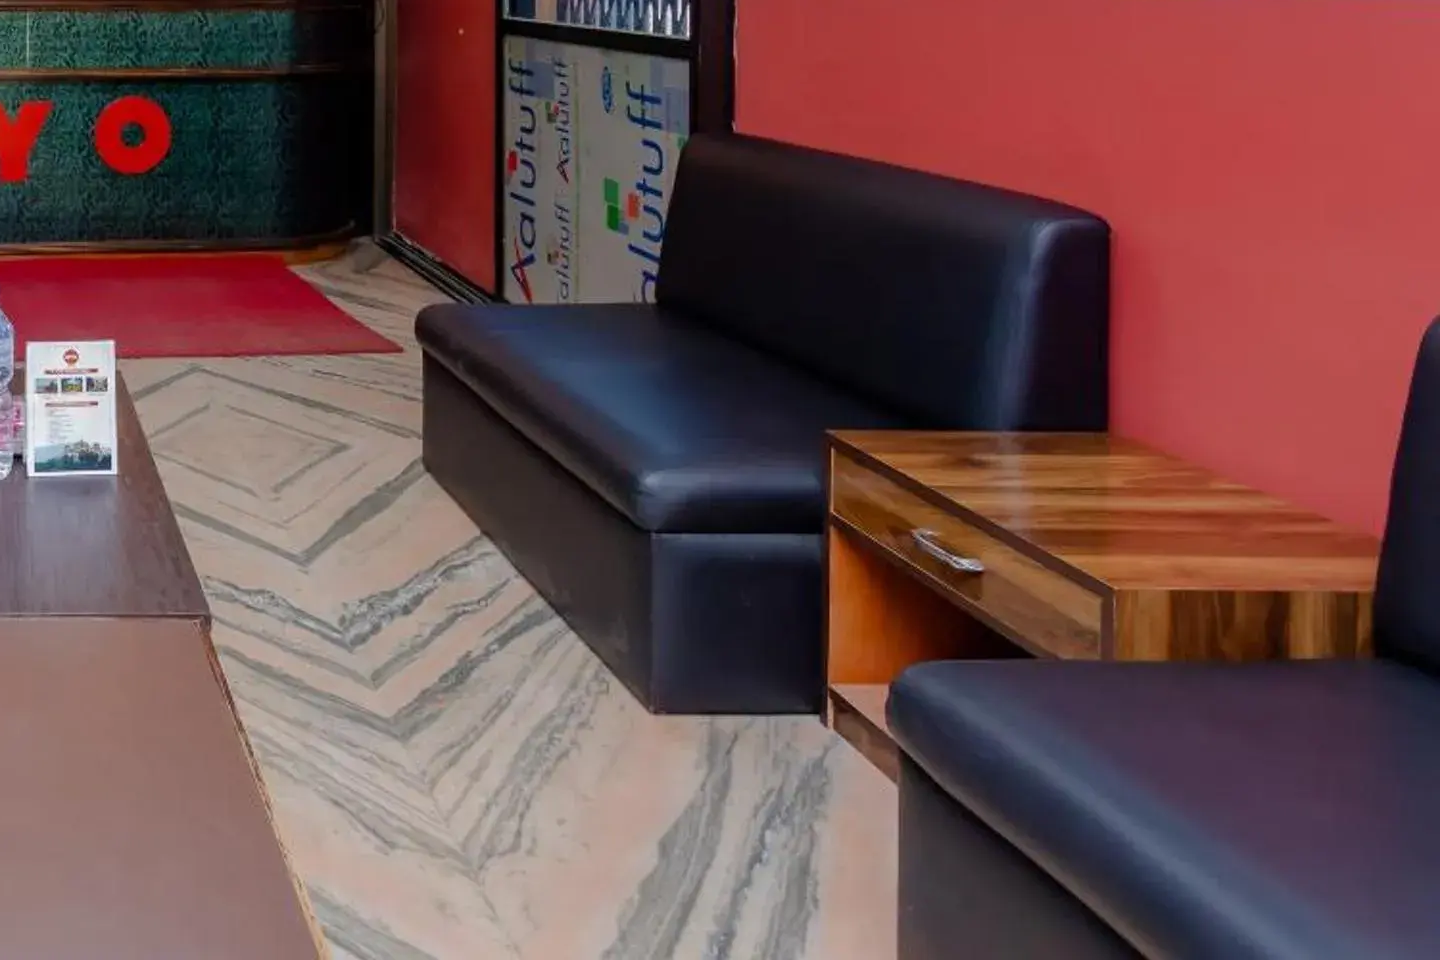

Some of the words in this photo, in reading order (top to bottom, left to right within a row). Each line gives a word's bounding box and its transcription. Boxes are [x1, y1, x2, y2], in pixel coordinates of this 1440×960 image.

[510, 57, 537, 302] Aalutuff
[554, 203, 570, 300] alutuff
[627, 80, 664, 302] alutuff
